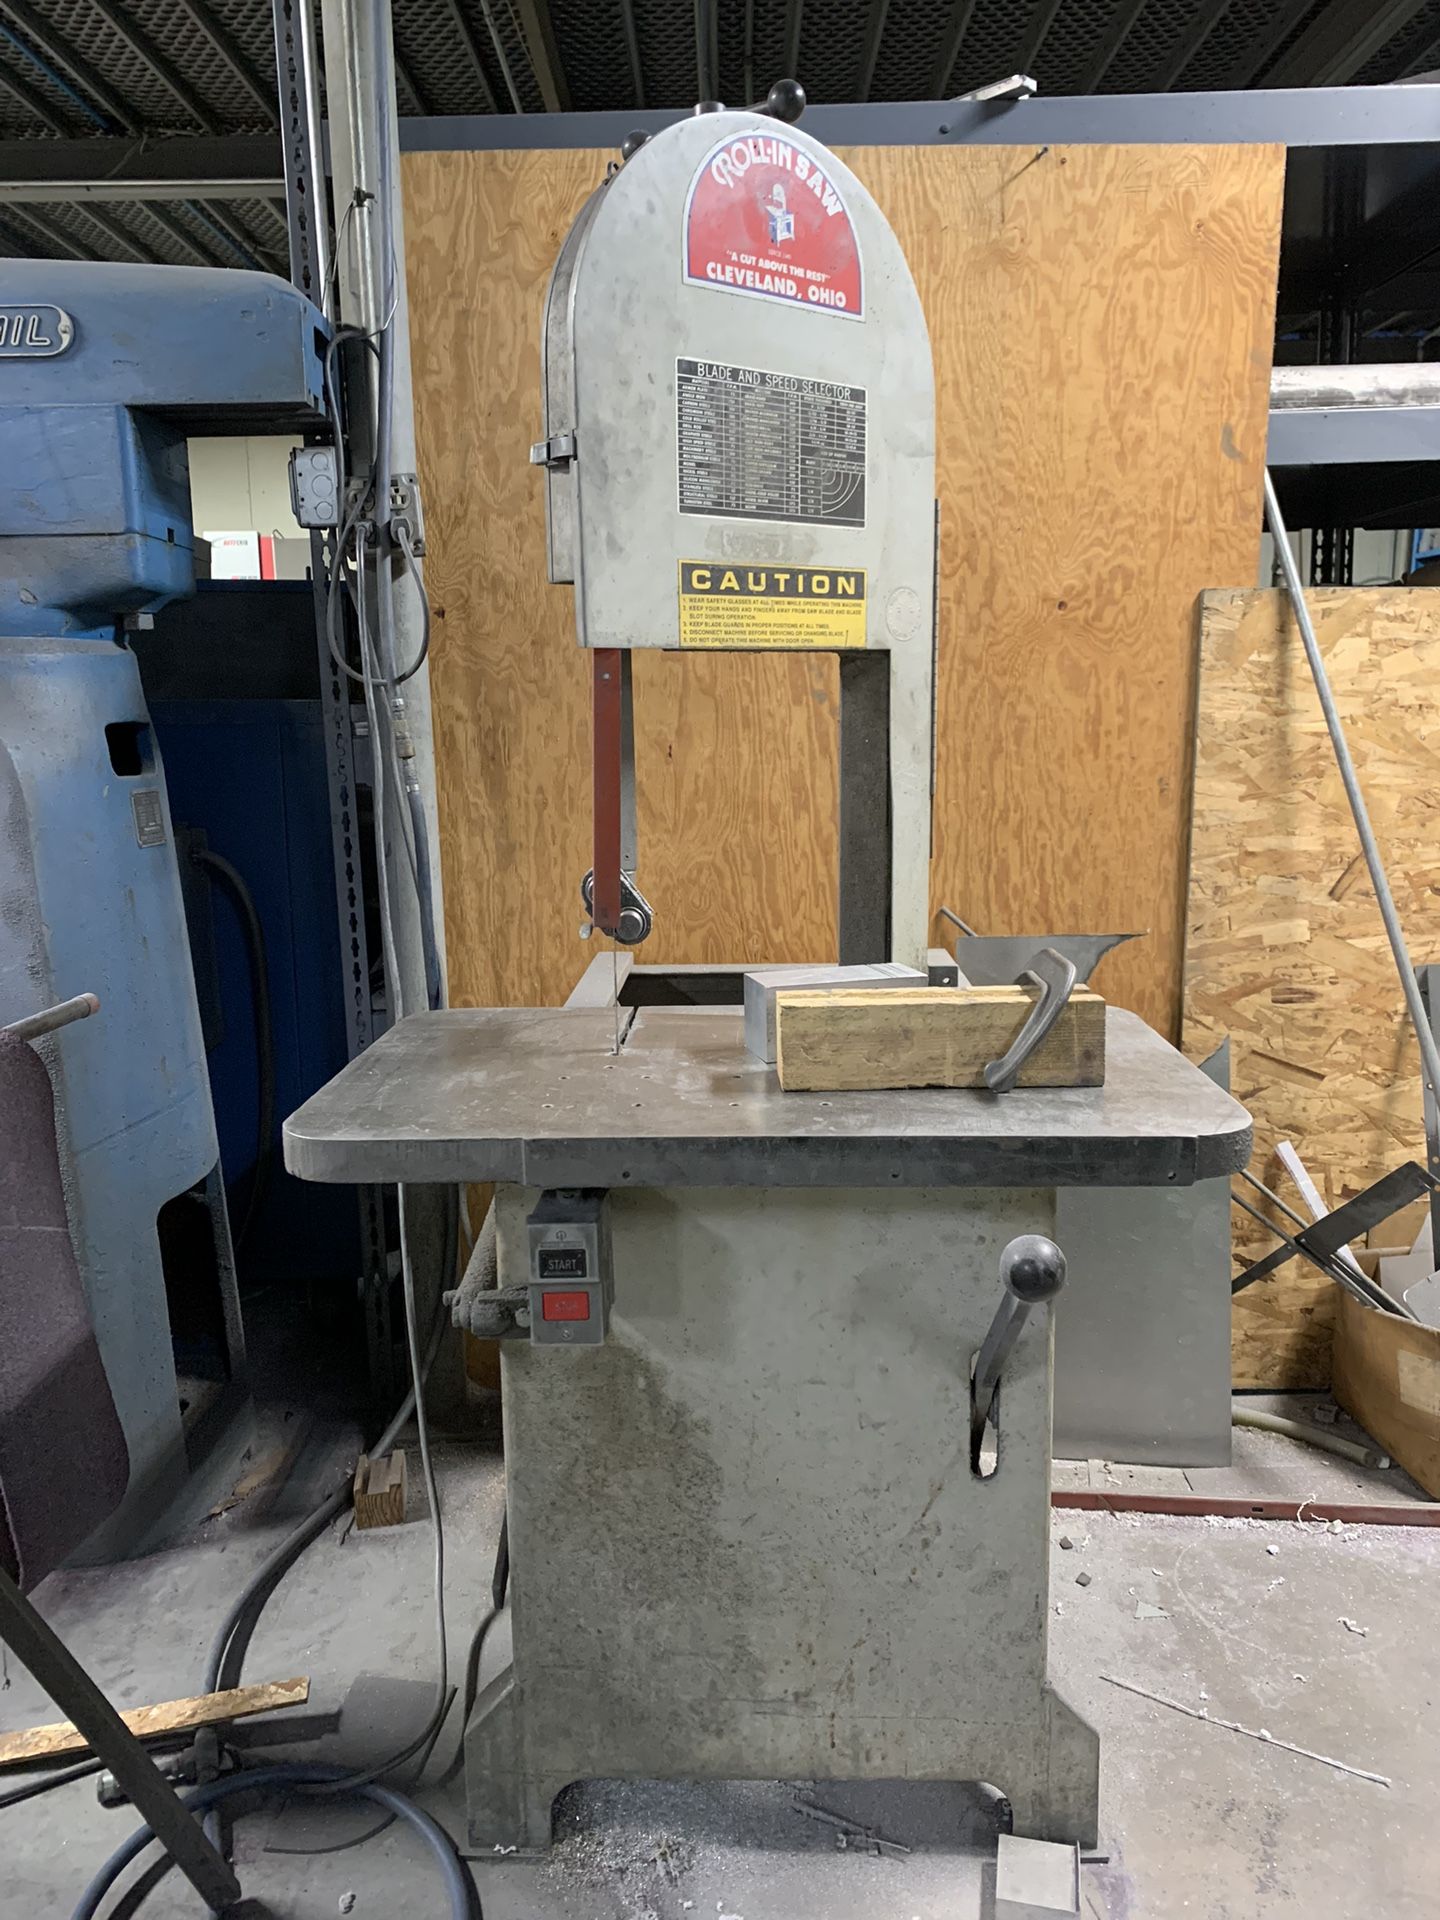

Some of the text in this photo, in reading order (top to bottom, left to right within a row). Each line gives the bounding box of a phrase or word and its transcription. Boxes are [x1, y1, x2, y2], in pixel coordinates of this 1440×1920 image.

[794, 154, 844, 216] SAW
[740, 254, 756, 266] CUT
[758, 258, 788, 273] ABOVE
[789, 265, 804, 277] THE
[706, 262, 846, 308] CLEVELAND, OHIO
[698, 363, 850, 400] BLADE AND SPEED SELECTOR
[691, 569, 855, 595] CAUTION
[548, 1259, 576, 1270] START
